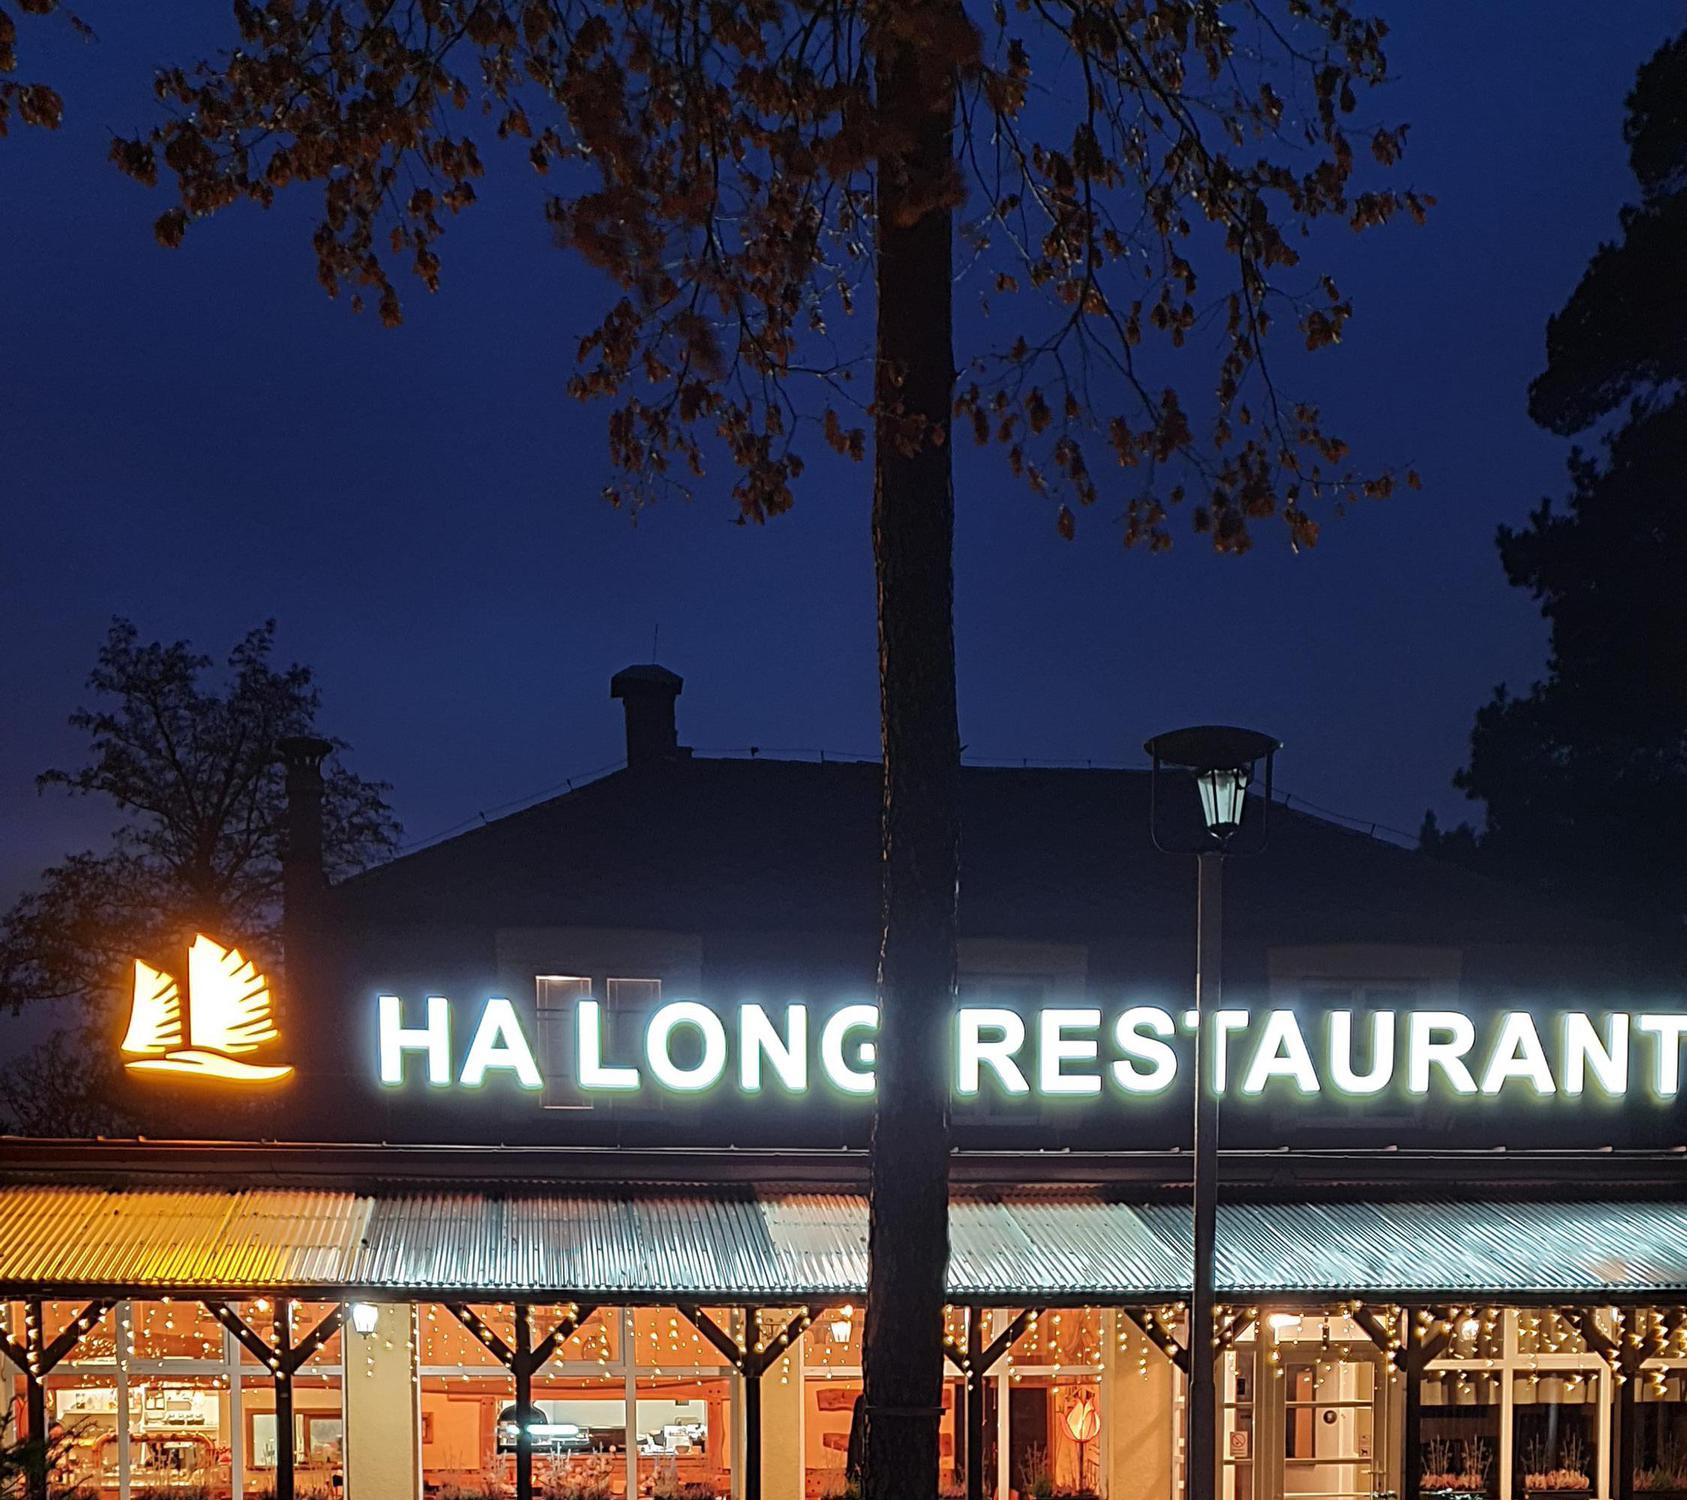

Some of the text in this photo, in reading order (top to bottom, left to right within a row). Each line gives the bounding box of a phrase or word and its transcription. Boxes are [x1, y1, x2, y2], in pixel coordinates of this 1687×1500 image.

[378, 995, 1687, 1096] HA LONG RESTAURANT
